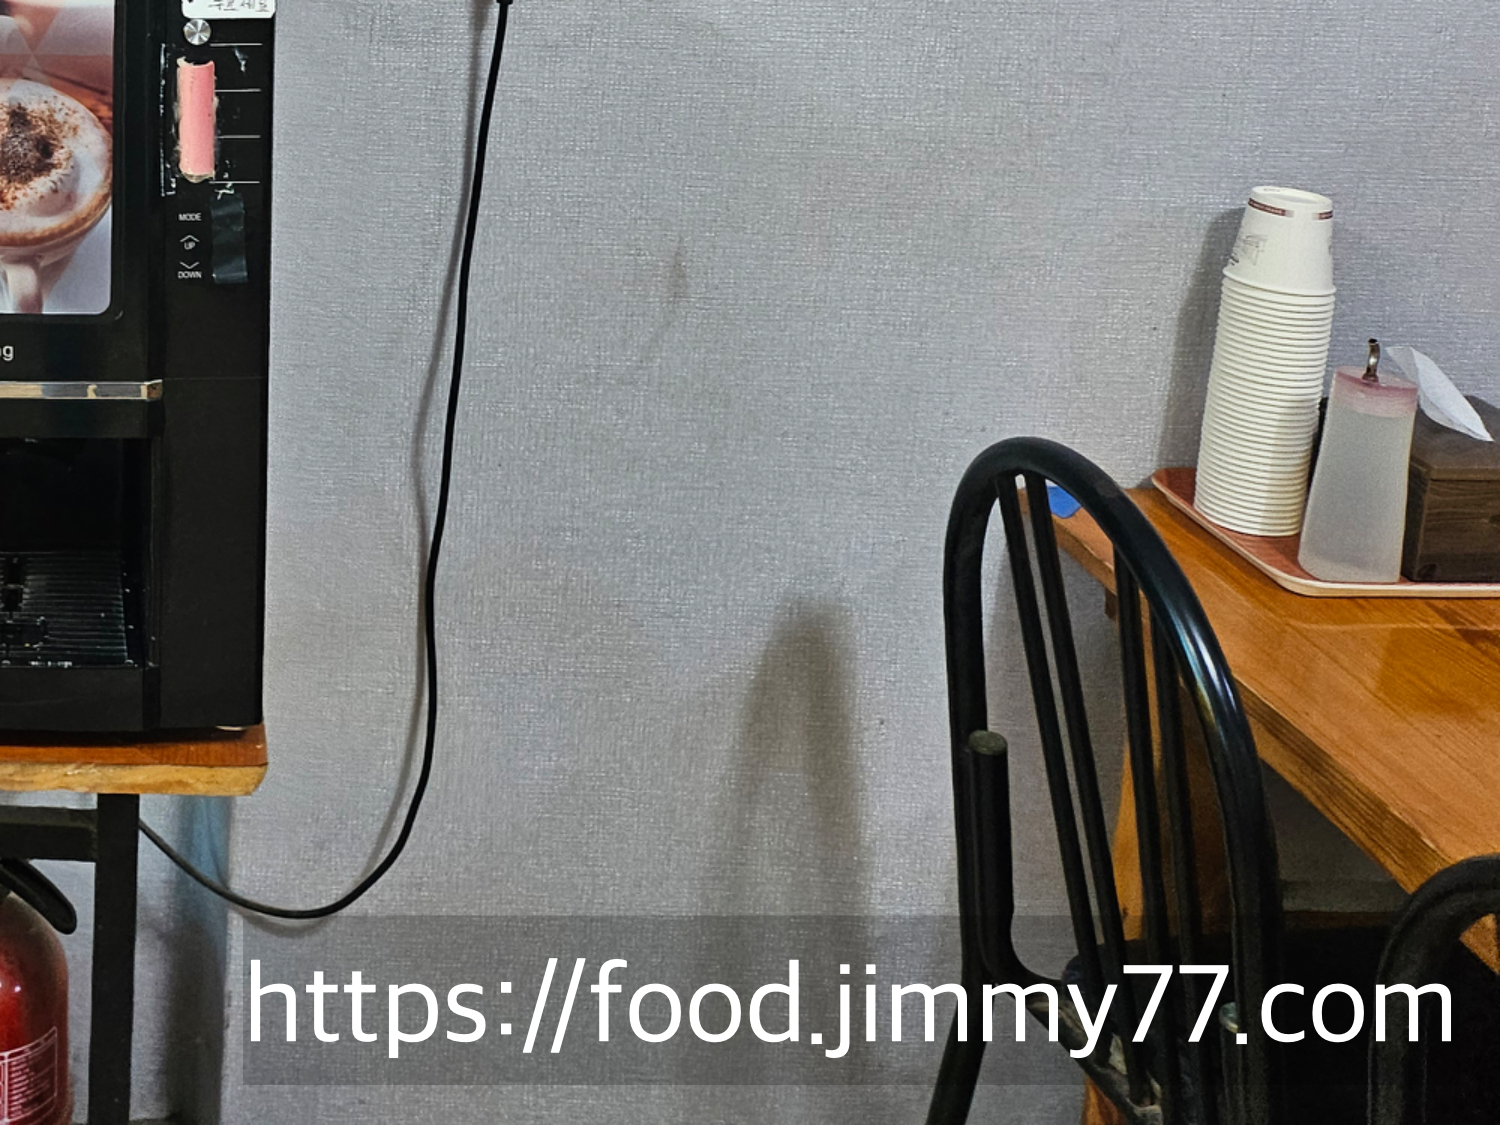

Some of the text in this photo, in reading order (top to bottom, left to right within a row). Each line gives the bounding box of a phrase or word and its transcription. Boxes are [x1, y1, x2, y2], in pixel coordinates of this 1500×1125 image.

[178, 212, 202, 221] MODE
[184, 241, 196, 250] UP
[177, 270, 202, 279] DOWN
